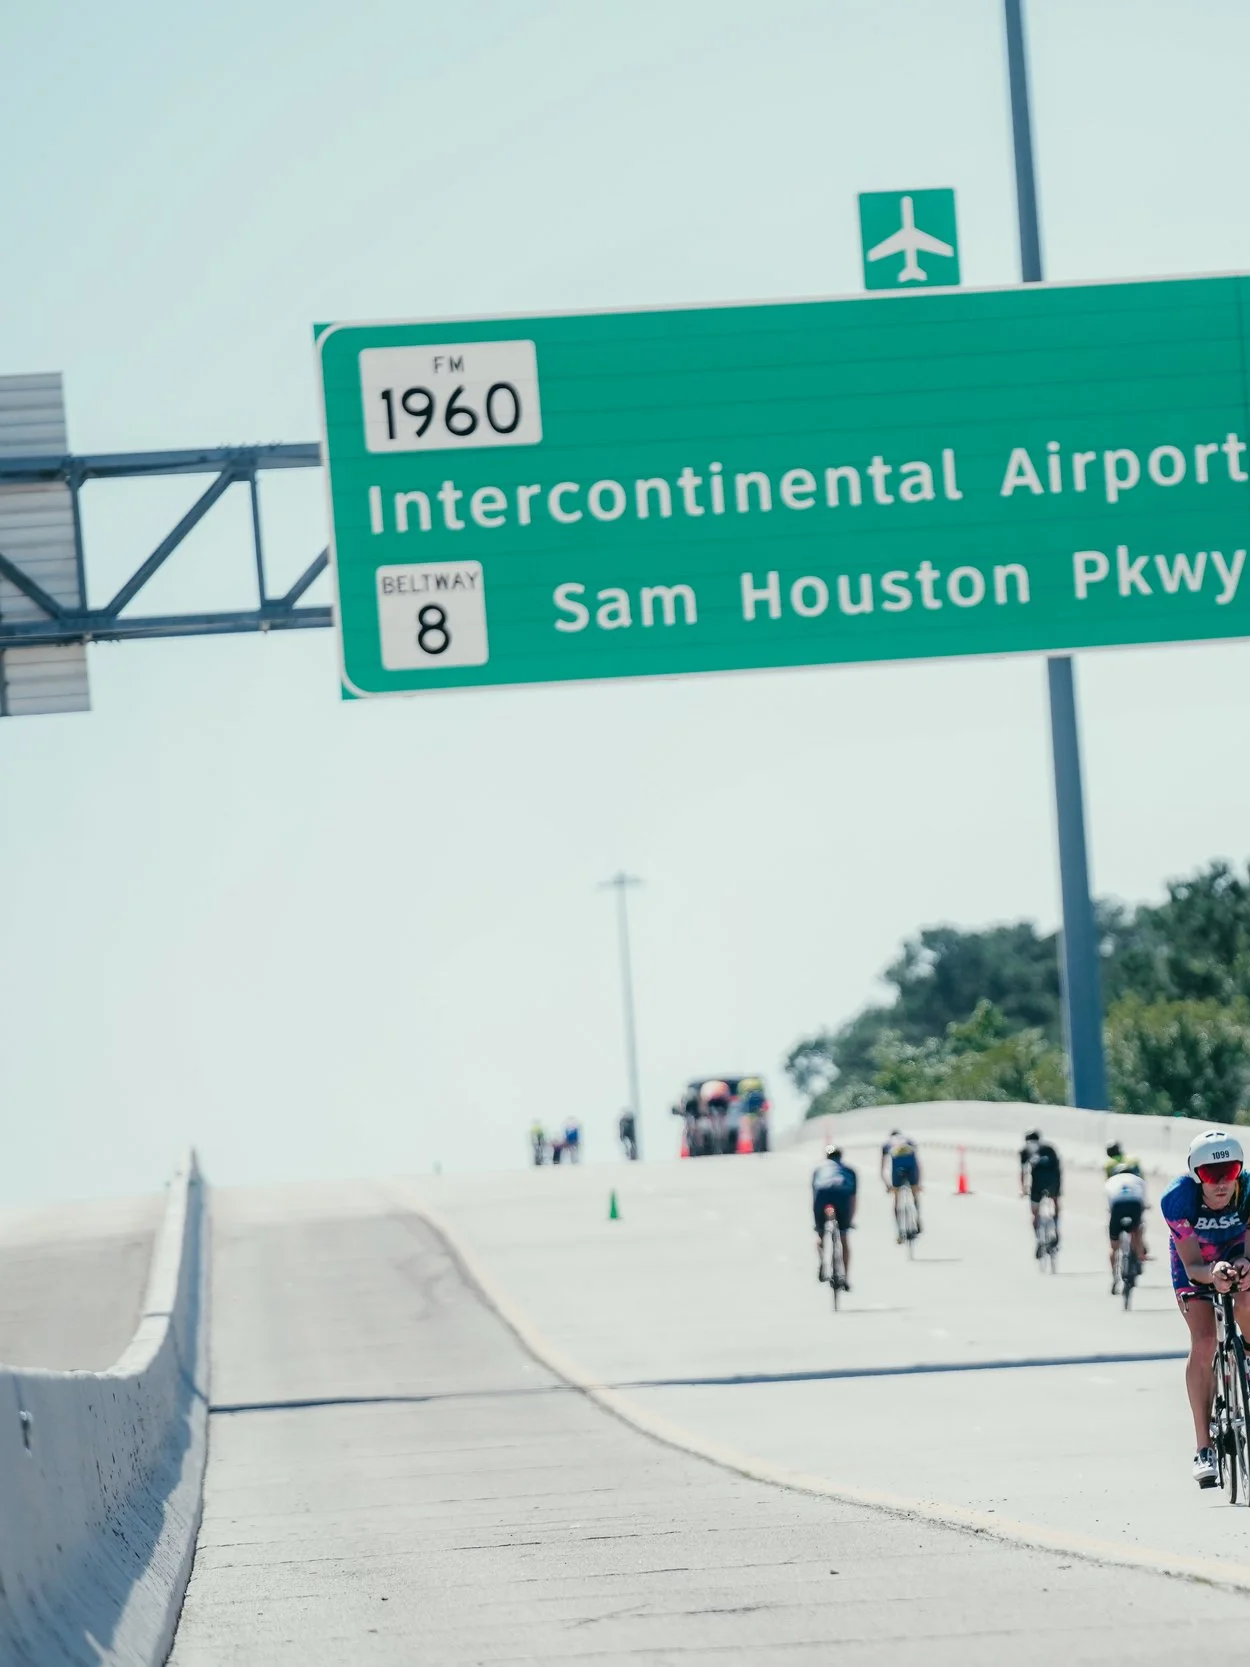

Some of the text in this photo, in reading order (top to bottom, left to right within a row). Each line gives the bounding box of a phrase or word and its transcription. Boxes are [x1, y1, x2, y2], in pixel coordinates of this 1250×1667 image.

[433, 355, 465, 374] FM
[380, 381, 522, 441] 1960
[368, 447, 963, 535] Intercontinental
[1000, 432, 1249, 504] Airport
[381, 572, 480, 596] BELTWAY
[553, 582, 698, 634] Sam
[741, 560, 1030, 621] Houston
[1073, 545, 1247, 605] Pkwy
[416, 603, 452, 656] 8
[1212, 1150, 1230, 1160] 1099
